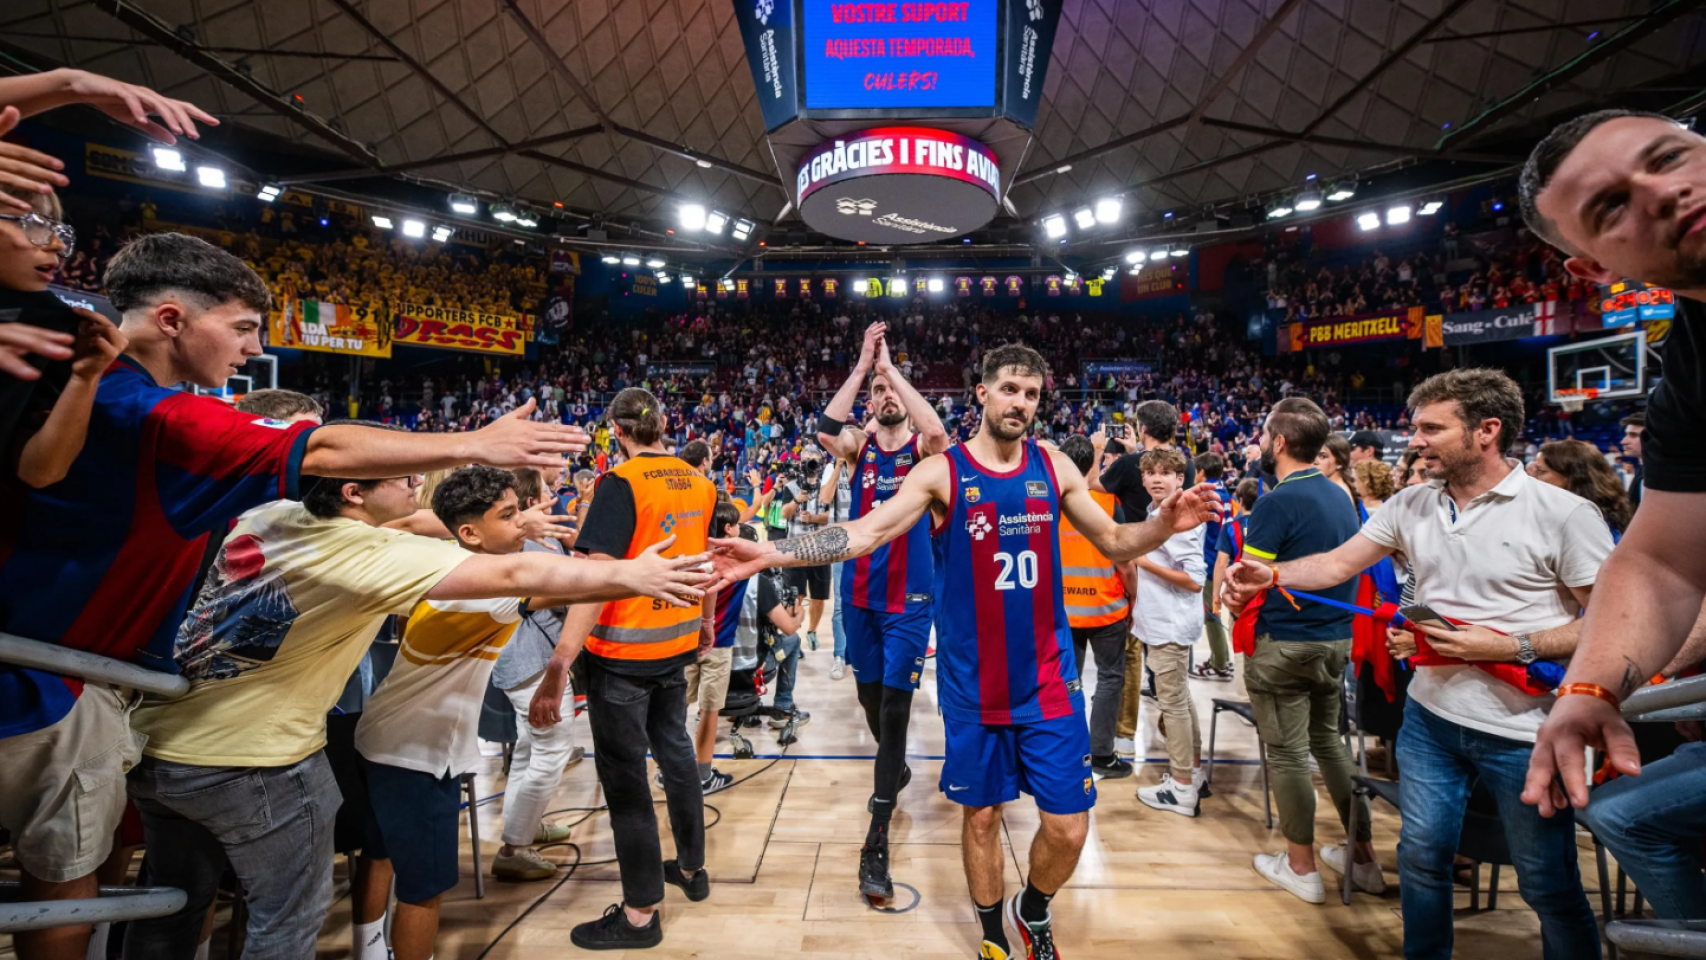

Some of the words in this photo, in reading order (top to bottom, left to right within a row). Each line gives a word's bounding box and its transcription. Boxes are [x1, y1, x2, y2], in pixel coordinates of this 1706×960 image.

[831, 3, 897, 23] VOSTRE
[901, 2, 969, 22] SUPORT
[825, 38, 886, 61] AQUESTA
[888, 37, 976, 58] TEMPORADA,
[863, 70, 938, 91] CULERS!
[811, 139, 894, 182] GRÀCIES
[900, 138, 909, 165] I
[915, 138, 963, 171] FINS
[1614, 291, 1637, 312] 24
[1649, 289, 1673, 306] 24
[398, 303, 476, 325] UPPORTERS
[479, 314, 502, 328] FCB
[1310, 325, 1332, 342] PBB
[1333, 316, 1400, 340] MERITXELL
[321, 334, 345, 349] PER
[347, 338, 363, 350] TU
[998, 511, 1054, 525] Assistència
[998, 523, 1041, 536] Sanitària
[993, 549, 1039, 591] 20
